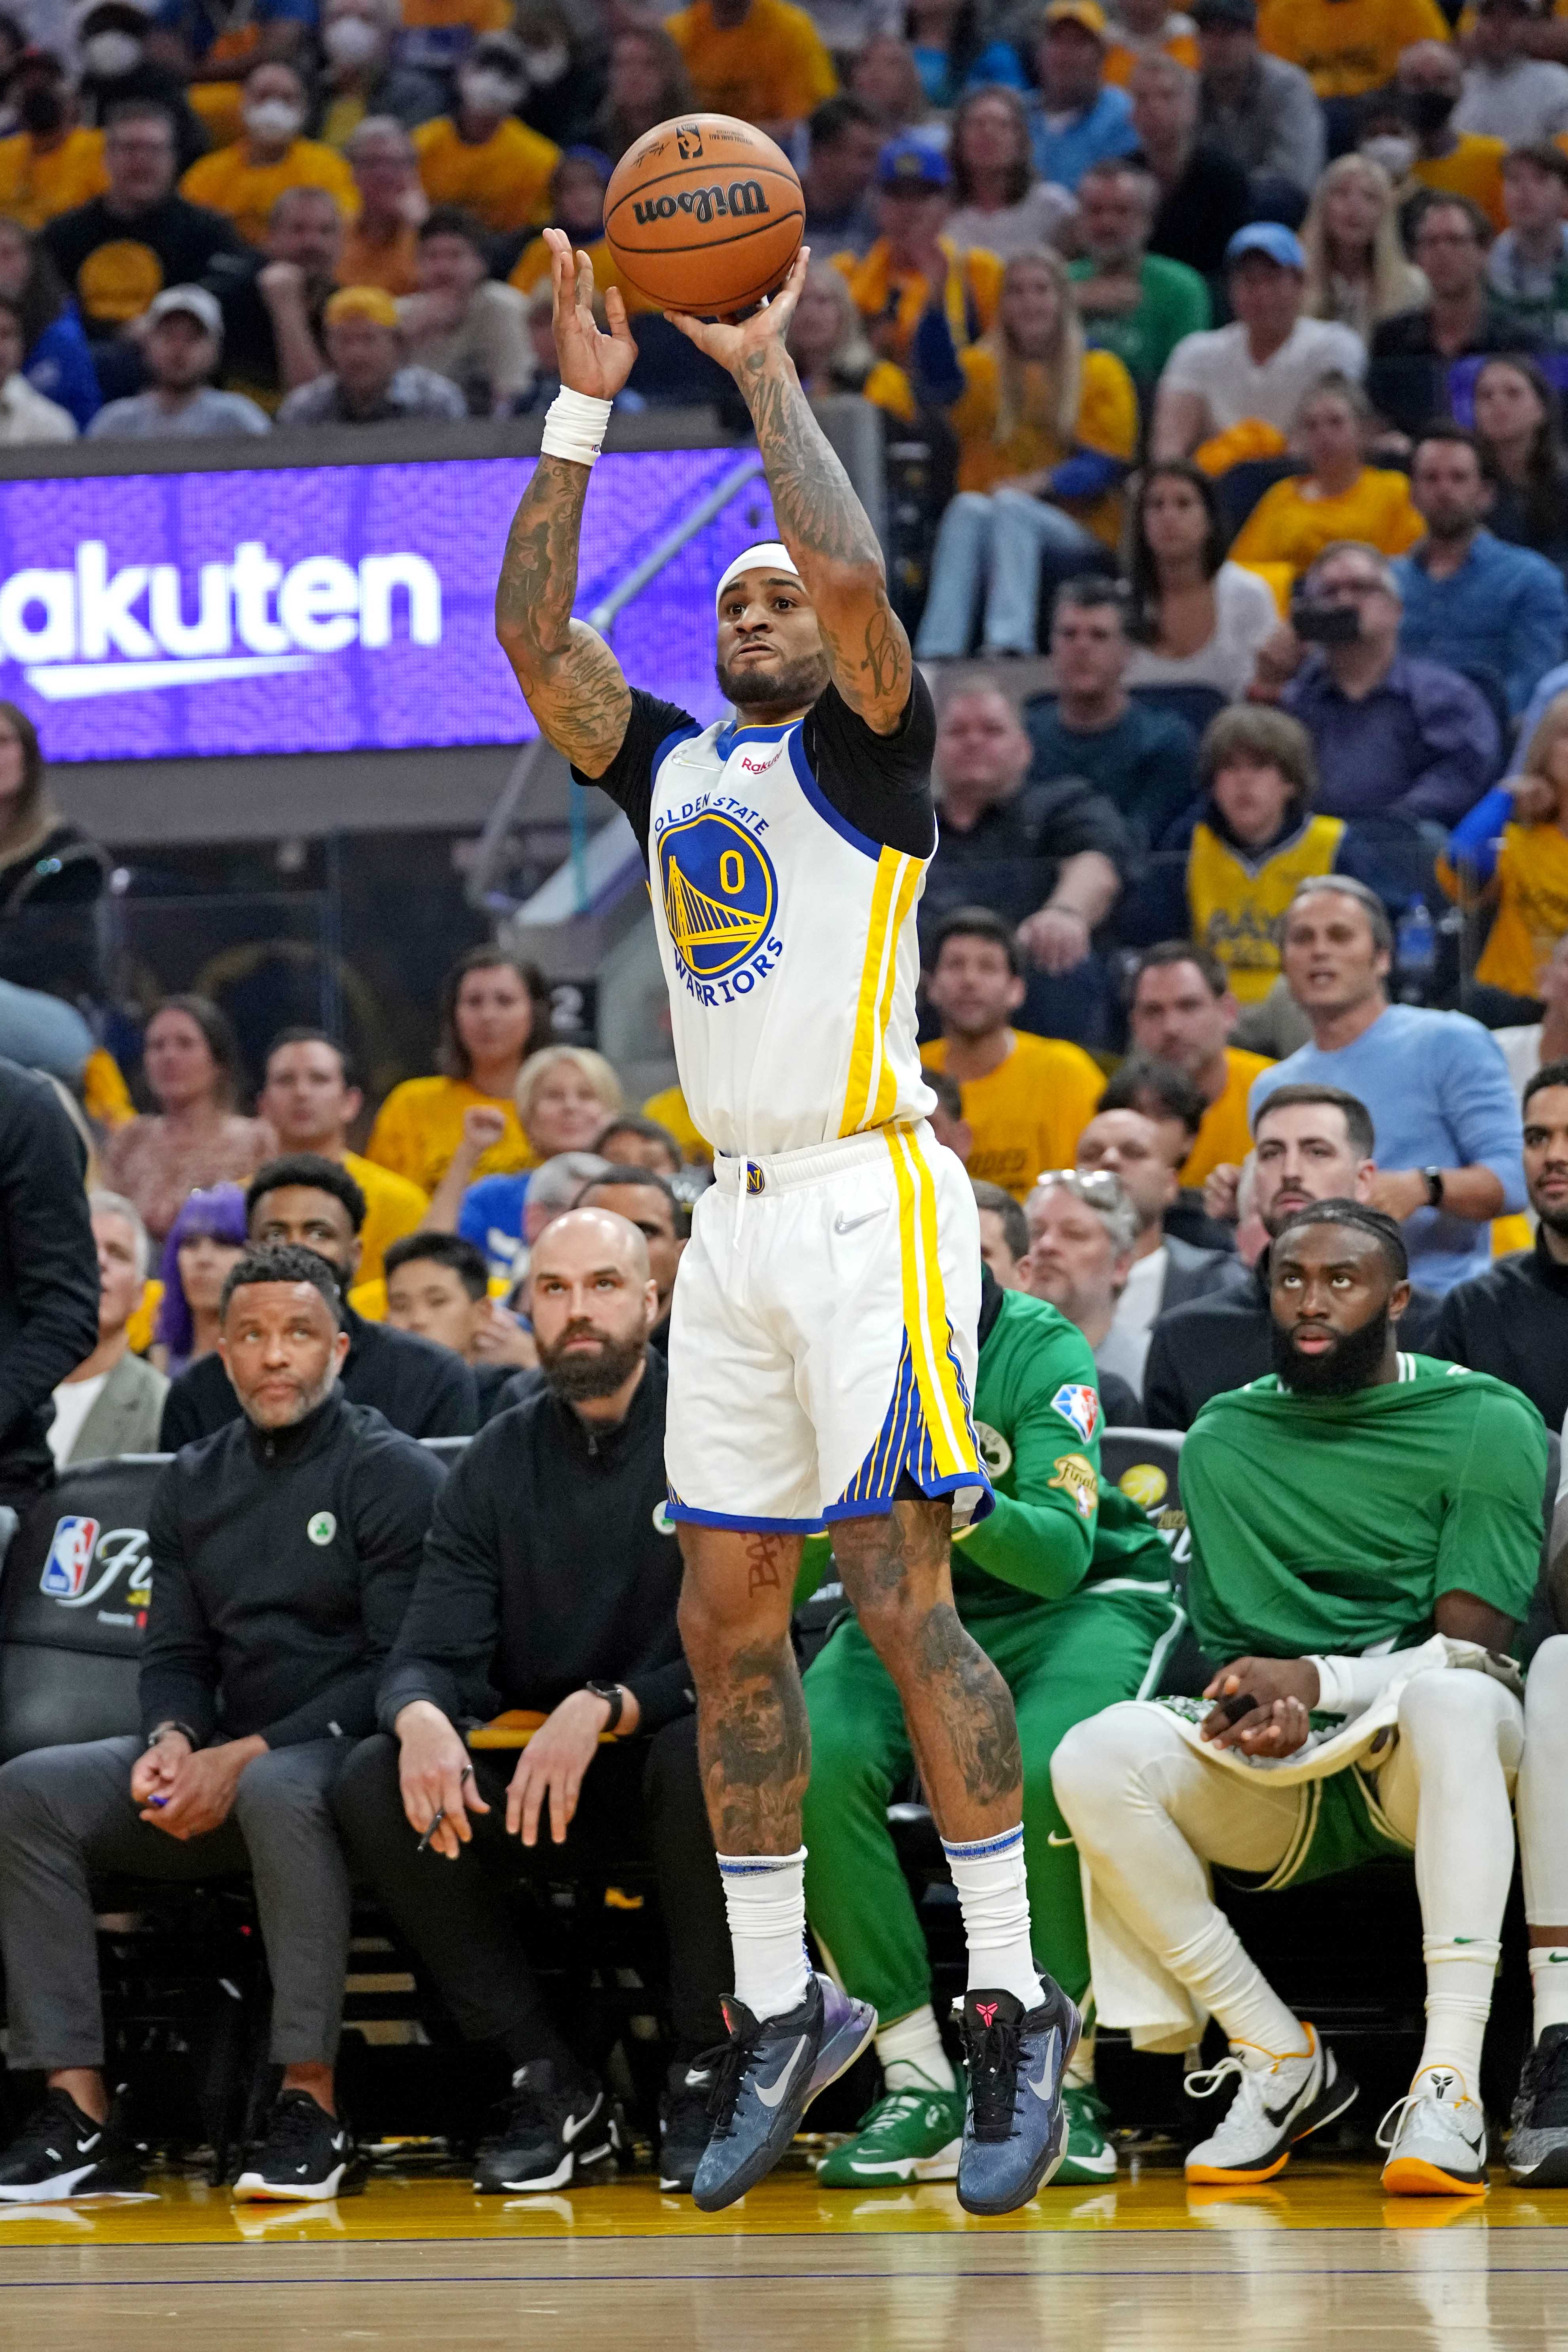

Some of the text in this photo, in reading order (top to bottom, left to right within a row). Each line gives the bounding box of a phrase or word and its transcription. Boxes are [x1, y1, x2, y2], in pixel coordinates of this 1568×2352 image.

[633, 180, 770, 225] Wilson
[0, 539, 442, 665] akuten
[655, 792, 769, 835] OLDEN STATE
[720, 850, 746, 894] 0
[673, 936, 783, 1007] WARRIORS
